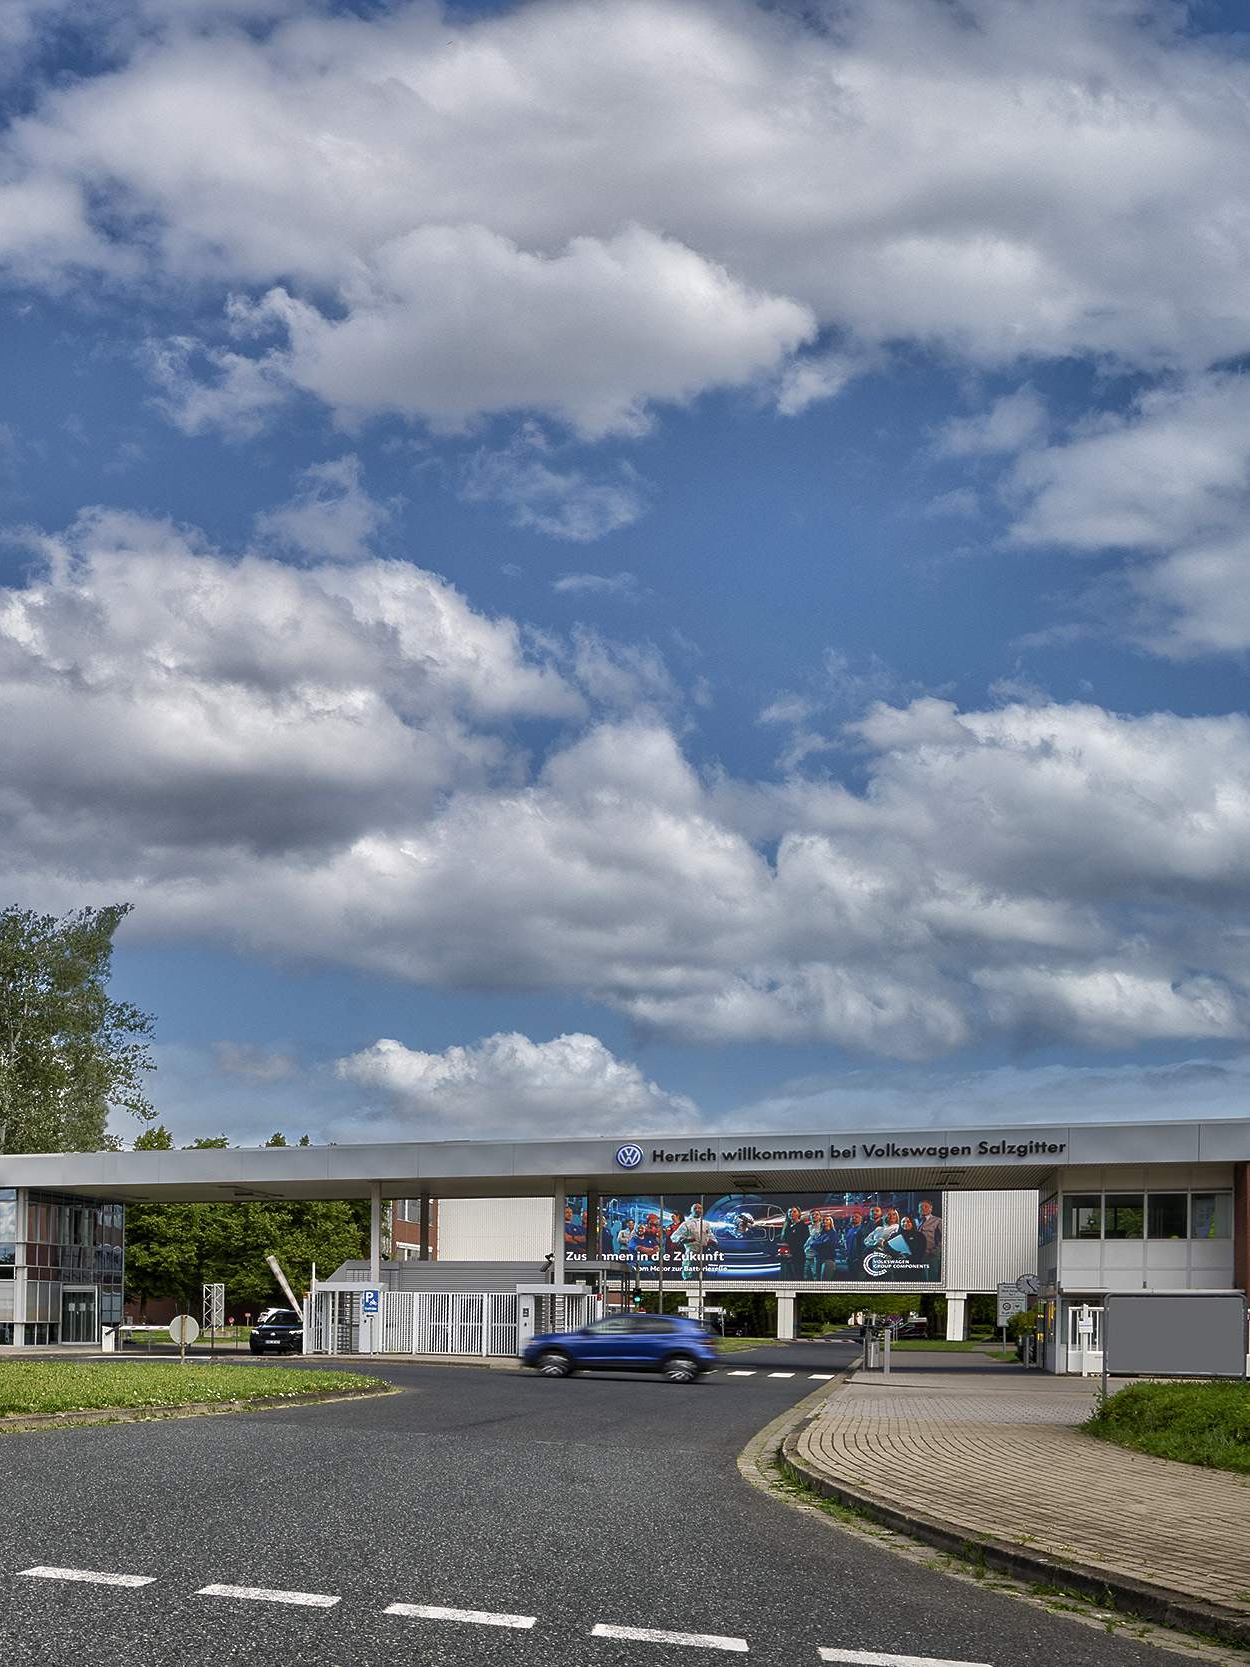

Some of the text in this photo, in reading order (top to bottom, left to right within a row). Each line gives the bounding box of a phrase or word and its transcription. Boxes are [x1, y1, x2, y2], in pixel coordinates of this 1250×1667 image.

[652, 1140, 1066, 1163] Herzlich willkommen bei Volkswagen Salzgitter
[566, 1251, 725, 1261] Zusmmen in de Zukunft
